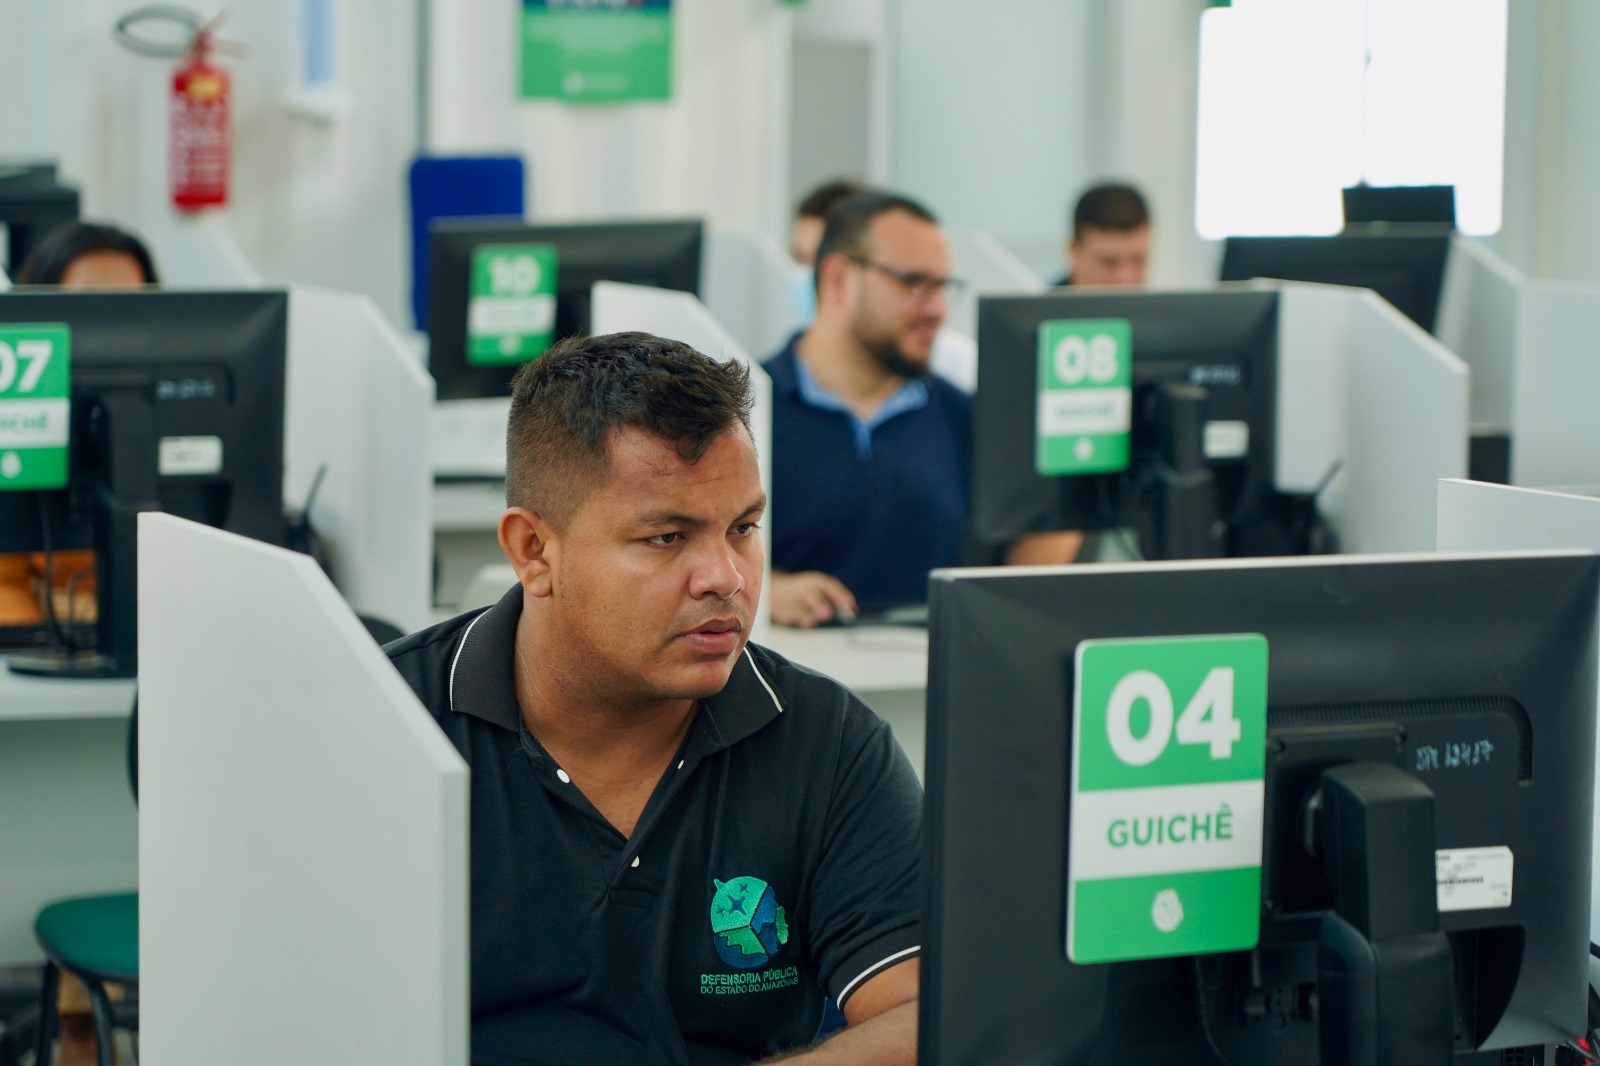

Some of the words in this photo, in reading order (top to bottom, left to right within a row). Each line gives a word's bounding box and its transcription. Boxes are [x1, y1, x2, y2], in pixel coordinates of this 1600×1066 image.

[489, 254, 541, 294] 10
[1053, 333, 1119, 385] 08
[1105, 666, 1241, 766] 04
[1106, 803, 1233, 847] GUICHÊ
[700, 985, 714, 994] DO
[715, 984, 747, 995] ESTADO
[748, 983, 761, 993] DO
[761, 977, 799, 992] AMAZONAS
[701, 972, 761, 986] DEFENSORIA
[763, 966, 798, 982] PÚBLICA
